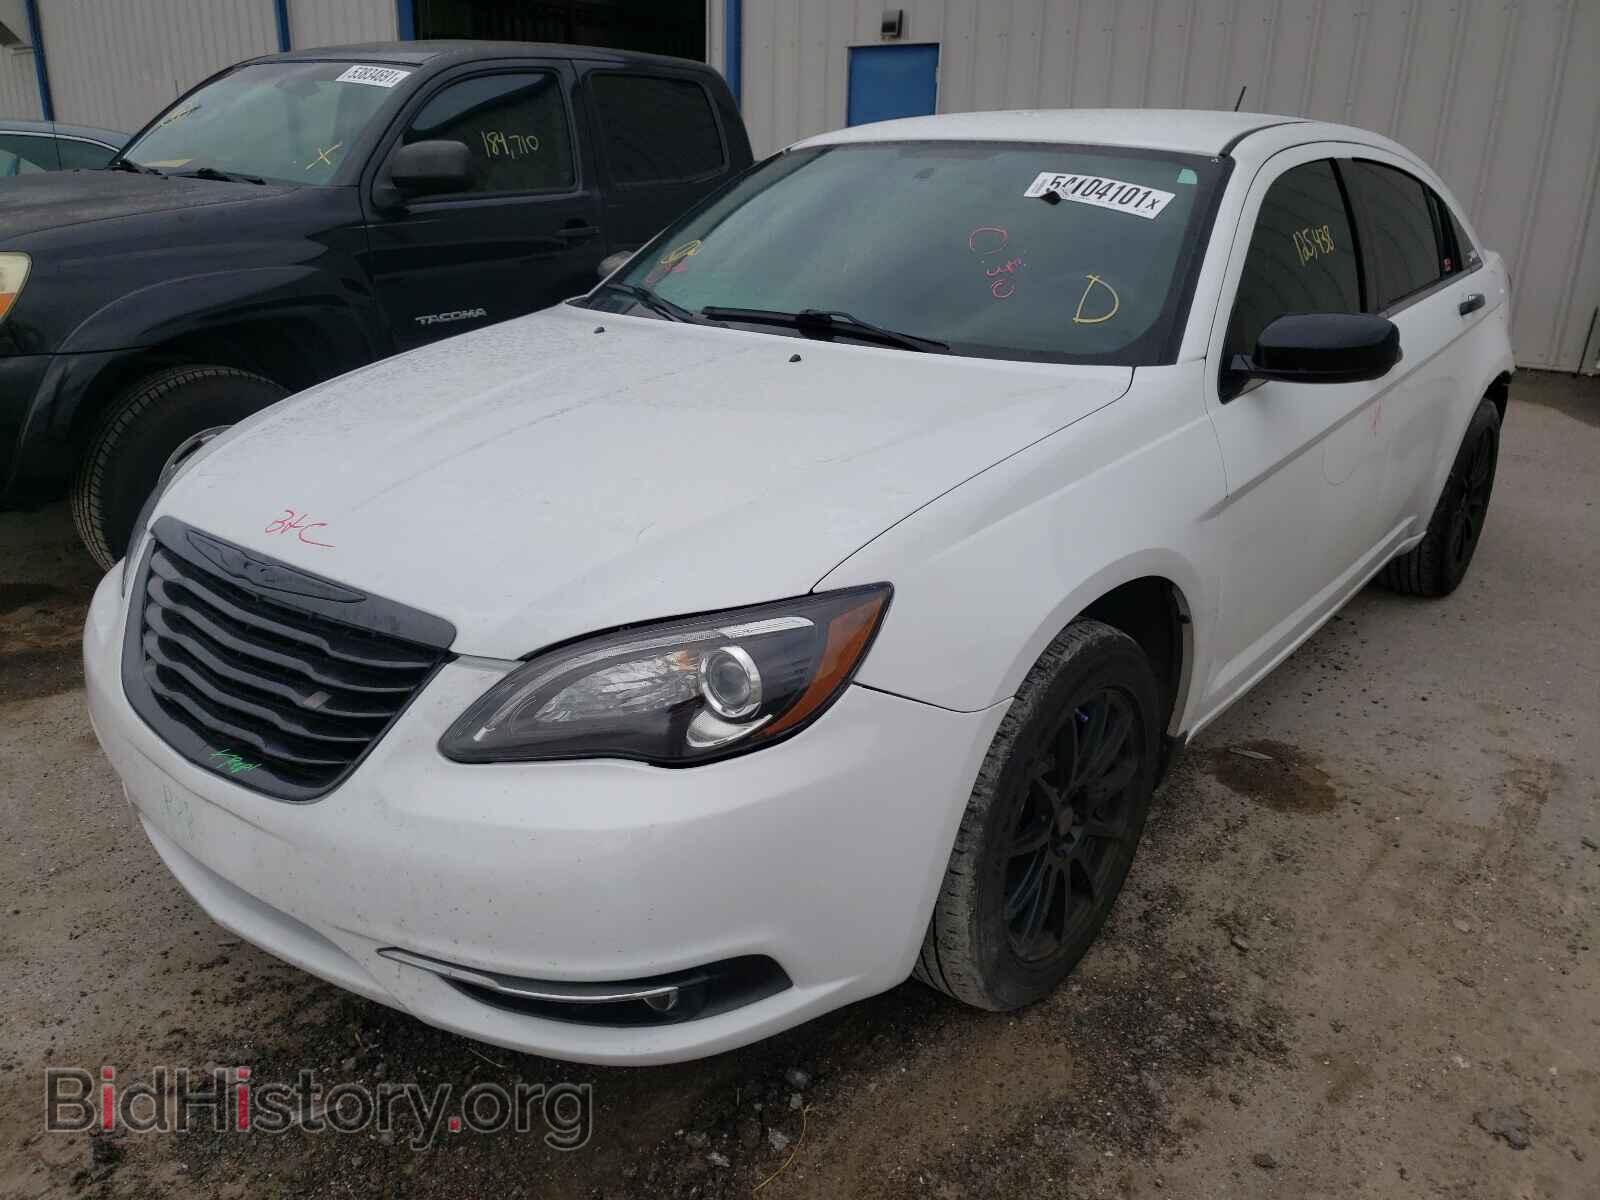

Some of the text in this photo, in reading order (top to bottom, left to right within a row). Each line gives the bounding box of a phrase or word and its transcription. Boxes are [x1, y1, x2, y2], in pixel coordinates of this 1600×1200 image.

[480, 130, 539, 159] 184,710
[1072, 274, 1120, 323] D
[415, 307, 487, 325] TACOMA
